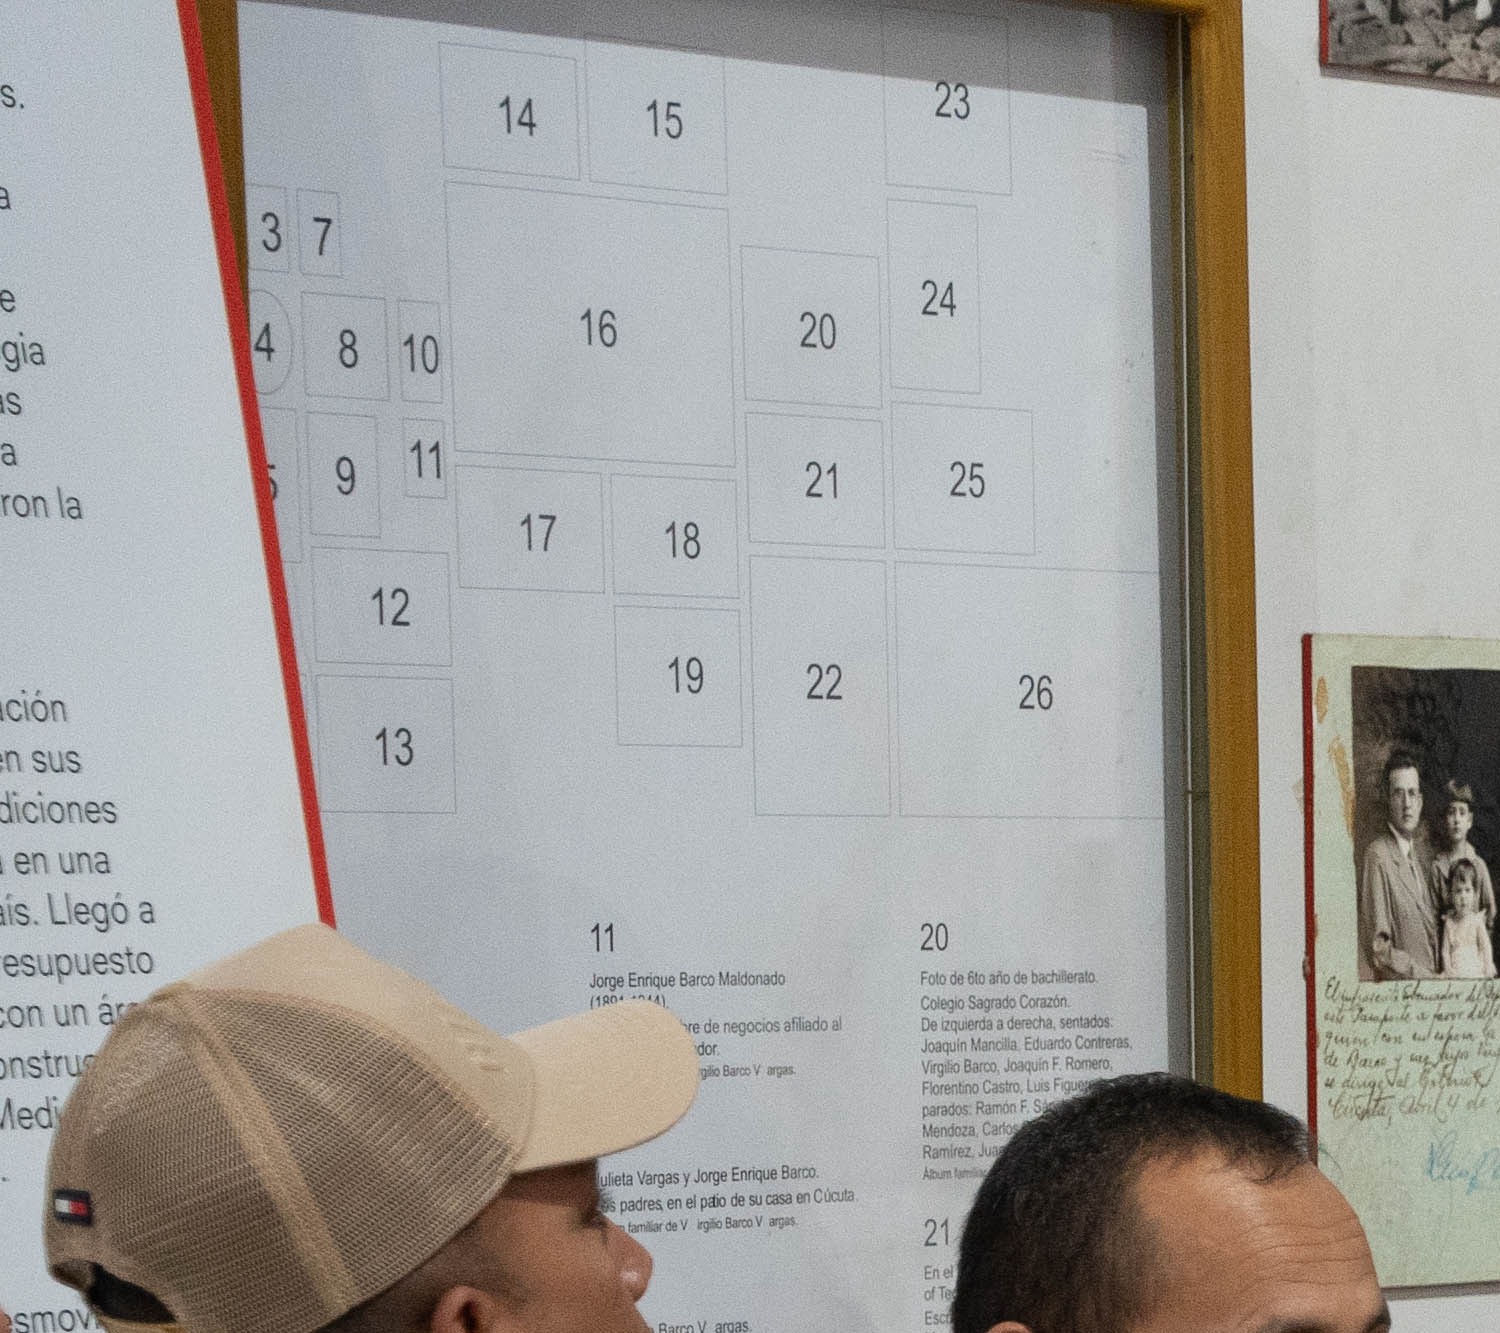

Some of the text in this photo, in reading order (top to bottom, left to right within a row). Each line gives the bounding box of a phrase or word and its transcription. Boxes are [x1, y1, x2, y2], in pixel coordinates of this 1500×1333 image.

[498, 95, 538, 137] 14
[646, 99, 684, 140] 15
[933, 79, 972, 121] 23
[261, 211, 283, 253] 3
[312, 216, 333, 257] 7
[921, 278, 957, 318] 24
[254, 322, 276, 362] 4
[580, 307, 618, 349] 16
[799, 310, 837, 350] 20
[338, 328, 359, 369] 8
[402, 333, 440, 375] 10
[335, 455, 357, 496] 9
[409, 439, 442, 480] 11
[805, 460, 838, 499] 21
[949, 460, 986, 499] 25
[56, 486, 84, 521] la
[520, 512, 557, 553] 17
[664, 520, 702, 560] 18
[371, 586, 411, 627] 12
[668, 656, 704, 695] 19
[806, 662, 843, 701] 22
[1018, 673, 1054, 711] 26
[31, 749, 82, 775] sus
[375, 726, 414, 767] 13
[13, 850, 112, 876] en una
[46, 892, 156, 934] Llegó a
[590, 922, 615, 953] 11
[919, 921, 949, 952] 20
[589, 970, 787, 991] Jorge Enrique Barco Maldonado
[919, 971, 948, 987] Foto
[949, 971, 965, 987] de
[966, 970, 987, 986] 6to
[988, 970, 1012, 986] año
[1012, 970, 1029, 986] de
[53, 1003, 89, 1028] un
[920, 994, 966, 1014] Colegio
[967, 994, 1017, 1012] Sagrado
[703, 1018, 720, 1035] de
[722, 1020, 782, 1038] negocios
[783, 1016, 829, 1033] afiliado
[636, 1170, 681, 1189] Vargas
[693, 1168, 729, 1187] Jorge
[730, 1166, 778, 1185] Enrique
[923, 1217, 949, 1248] 21
